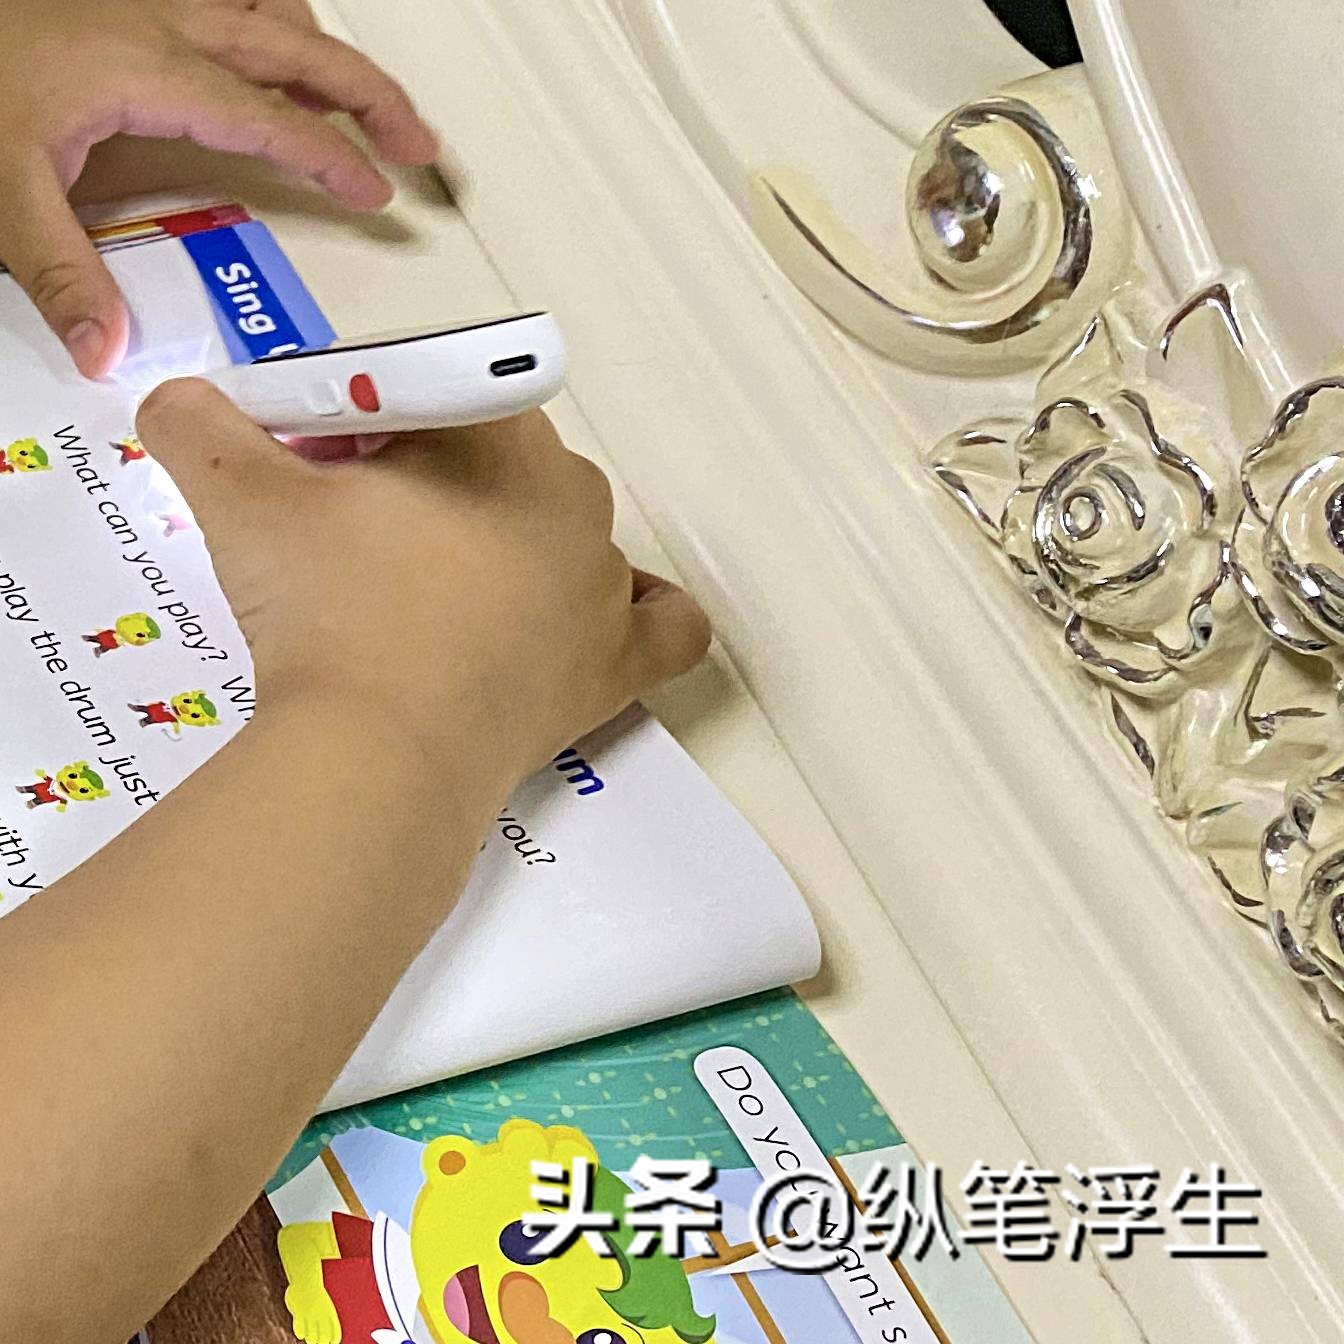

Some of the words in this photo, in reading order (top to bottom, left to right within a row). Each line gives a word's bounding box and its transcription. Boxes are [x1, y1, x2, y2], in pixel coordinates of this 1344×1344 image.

[215, 262, 277, 336] Sing
[53, 424, 110, 496] What
[98, 501, 138, 545] can
[122, 551, 175, 596] you
[157, 601, 229, 662] play?
[30, 630, 68, 674] the
[59, 681, 117, 747] drum
[98, 755, 160, 806] just
[716, 1065, 764, 1116] Do
